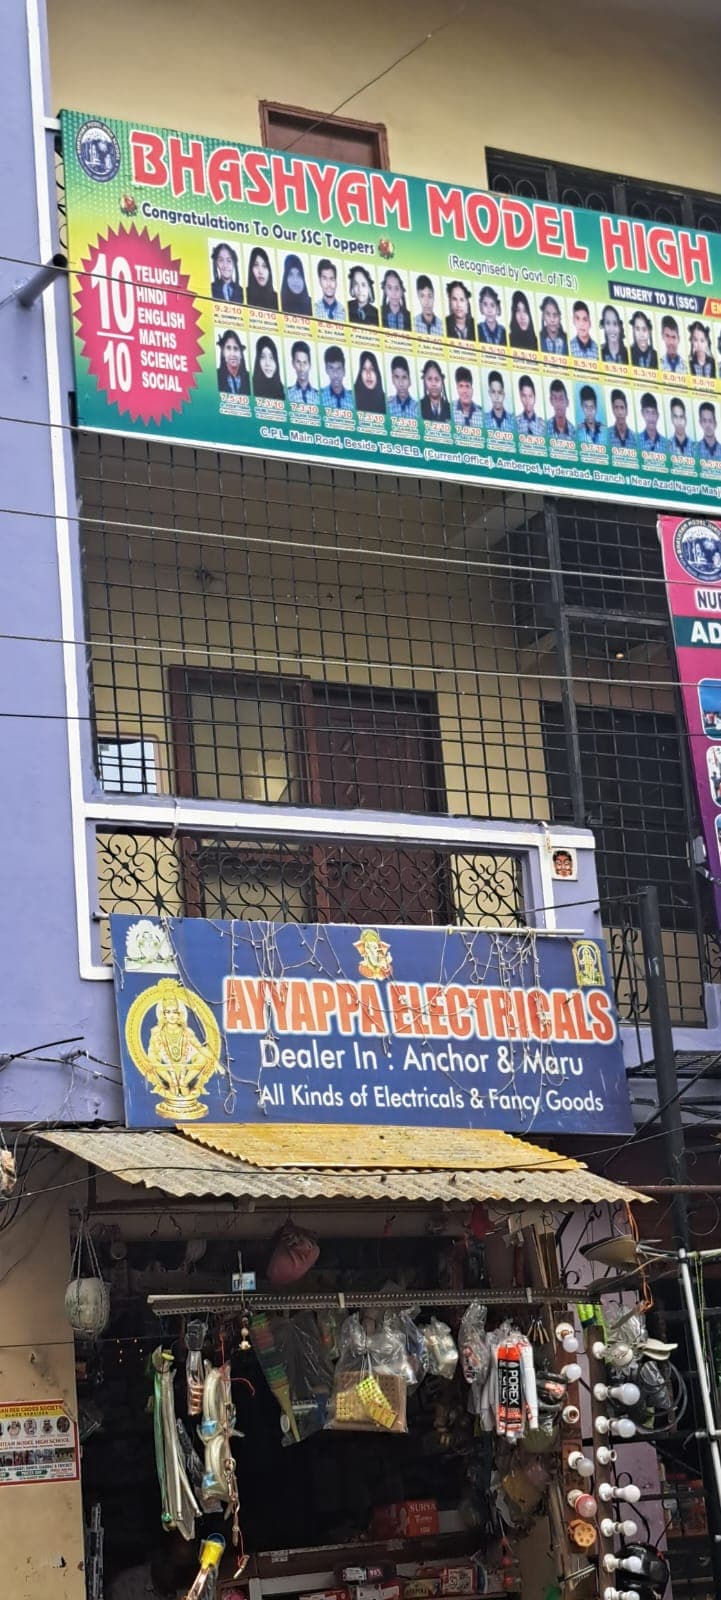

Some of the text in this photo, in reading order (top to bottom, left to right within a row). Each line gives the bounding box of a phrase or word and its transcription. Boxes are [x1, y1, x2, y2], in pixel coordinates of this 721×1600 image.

[130, 129, 412, 232] BHASHYAM
[426, 183, 588, 262] MODEL
[600, 216, 714, 286] HIGH
[142, 202, 375, 255] Congratulations To Our SSC Toppers
[134, 264, 179, 286] TELUGU
[449, 254, 506, 276] (Recognised
[508, 264, 519, 281] by
[547, 273, 558, 285] of
[91, 252, 135, 334] 10
[136, 286, 167, 306] HINDI
[613, 285, 698, 312] NURSERY TO X (SSC)
[137, 307, 186, 330] ENGLISH
[138, 328, 177, 349] MATHS
[103, 341, 133, 393] 10
[140, 351, 188, 372] SCIENCE
[141, 371, 183, 393] SOCIAL
[290, 431, 313, 443] Main
[315, 435, 343, 448] Road,
[345, 440, 377, 451] Beside
[497, 457, 543, 474] Amberpet,
[594, 471, 625, 483] Branch
[631, 475, 651, 487] Near
[652, 478, 674, 489] Azad
[675, 480, 700, 495] Nagar
[224, 977, 615, 1044] AYYAPPA ELECTRICALS
[260, 1039, 584, 1076] Dealer In : Anchor & Maru
[260, 1084, 604, 1113] All Kinds of Electricals & Fancy Goods
[508, 1369, 519, 1405] POREX
[409, 1503, 437, 1512] SURYA
